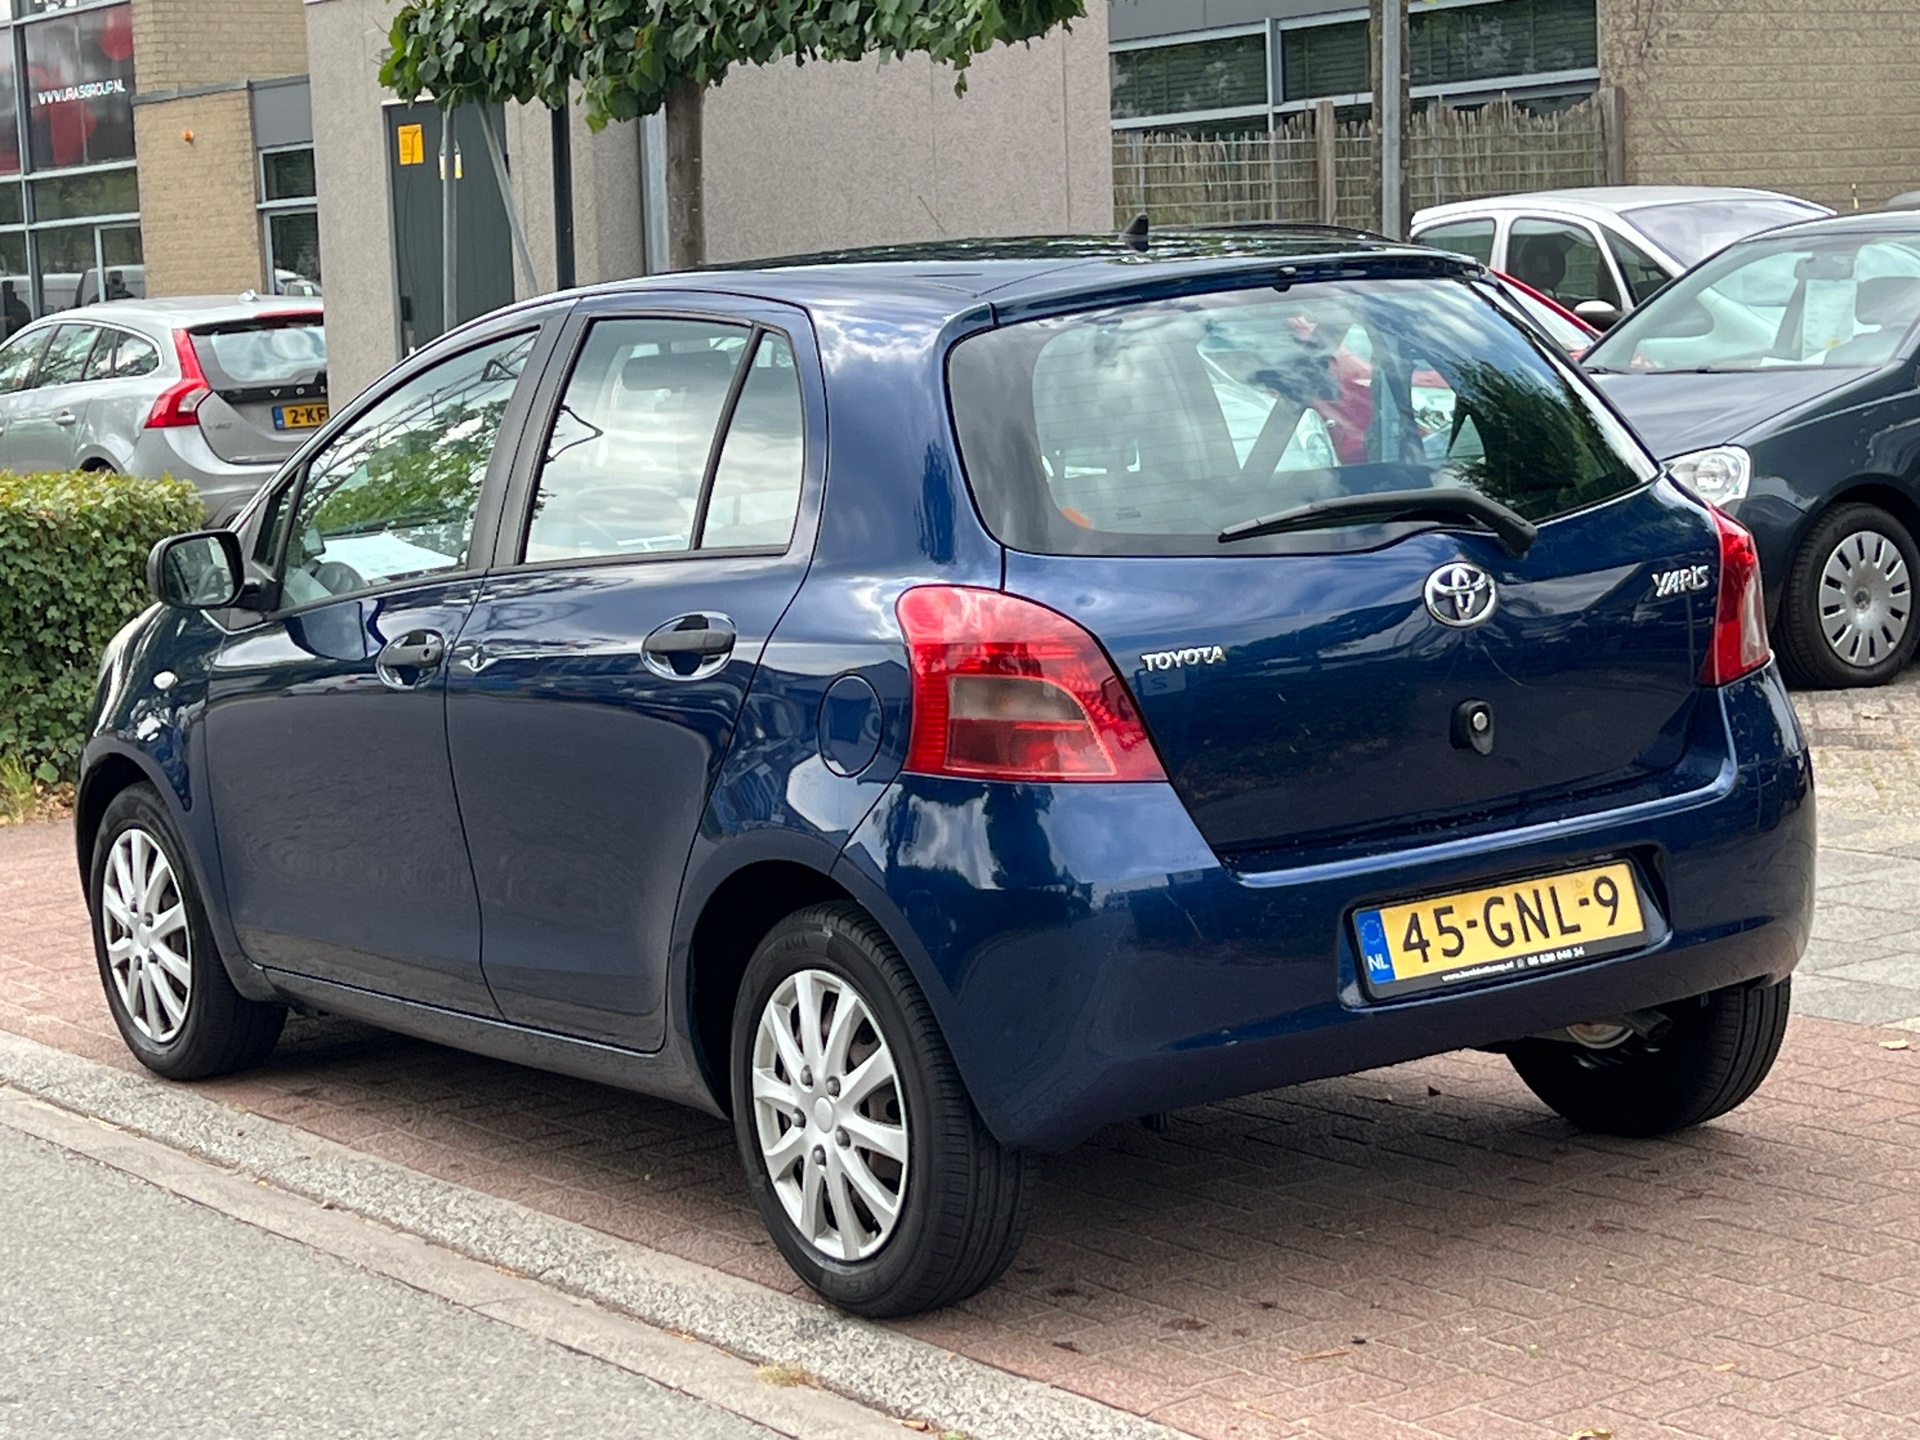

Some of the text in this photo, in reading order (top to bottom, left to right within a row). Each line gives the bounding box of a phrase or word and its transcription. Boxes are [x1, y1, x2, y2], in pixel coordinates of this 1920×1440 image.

[1651, 565, 1709, 597] YARIS
[1141, 645, 1226, 672] TOYOTA
[1402, 876, 1619, 963] 45-GNL-9
[1367, 953, 1390, 972] NL
